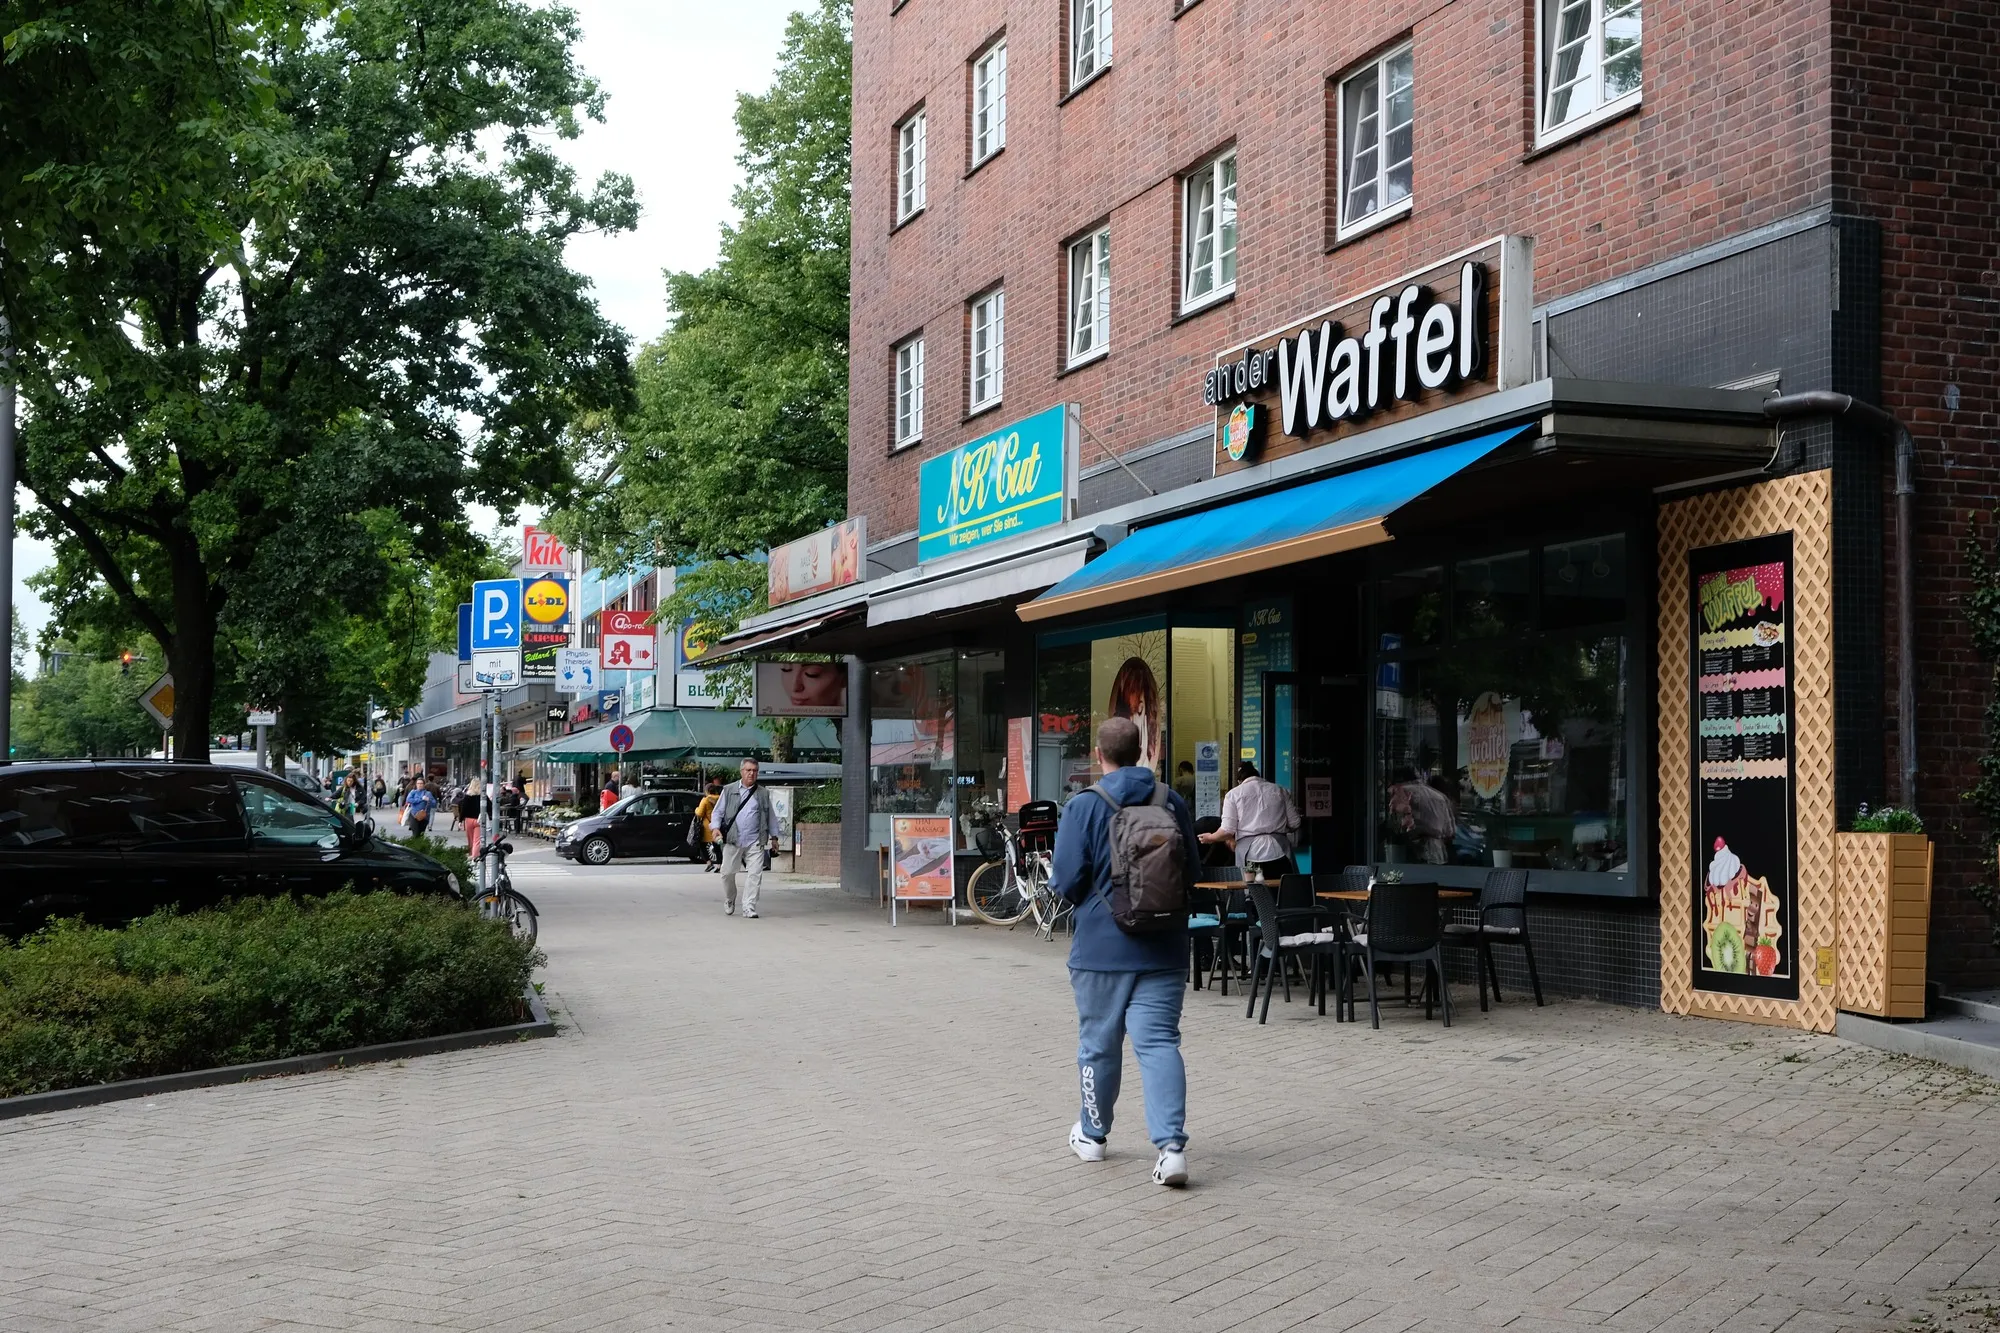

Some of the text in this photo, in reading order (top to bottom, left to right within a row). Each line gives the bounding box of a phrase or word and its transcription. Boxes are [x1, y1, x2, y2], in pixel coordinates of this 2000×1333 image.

[1203, 364, 1231, 406] an
[1234, 348, 1275, 396] der
[1277, 260, 1474, 436] Waffel
[995, 431, 1042, 503] Cut
[981, 523, 994, 537] wer
[993, 518, 1004, 534] Sie
[528, 534, 565, 565] kik
[483, 589, 509, 640] P
[523, 633, 567, 644] Queue
[489, 659, 502, 668] mit
[524, 650, 551, 663] Billard
[566, 650, 591, 659] Physio-
[549, 708, 566, 718] sky
[1082, 1064, 1103, 1130] adidas
